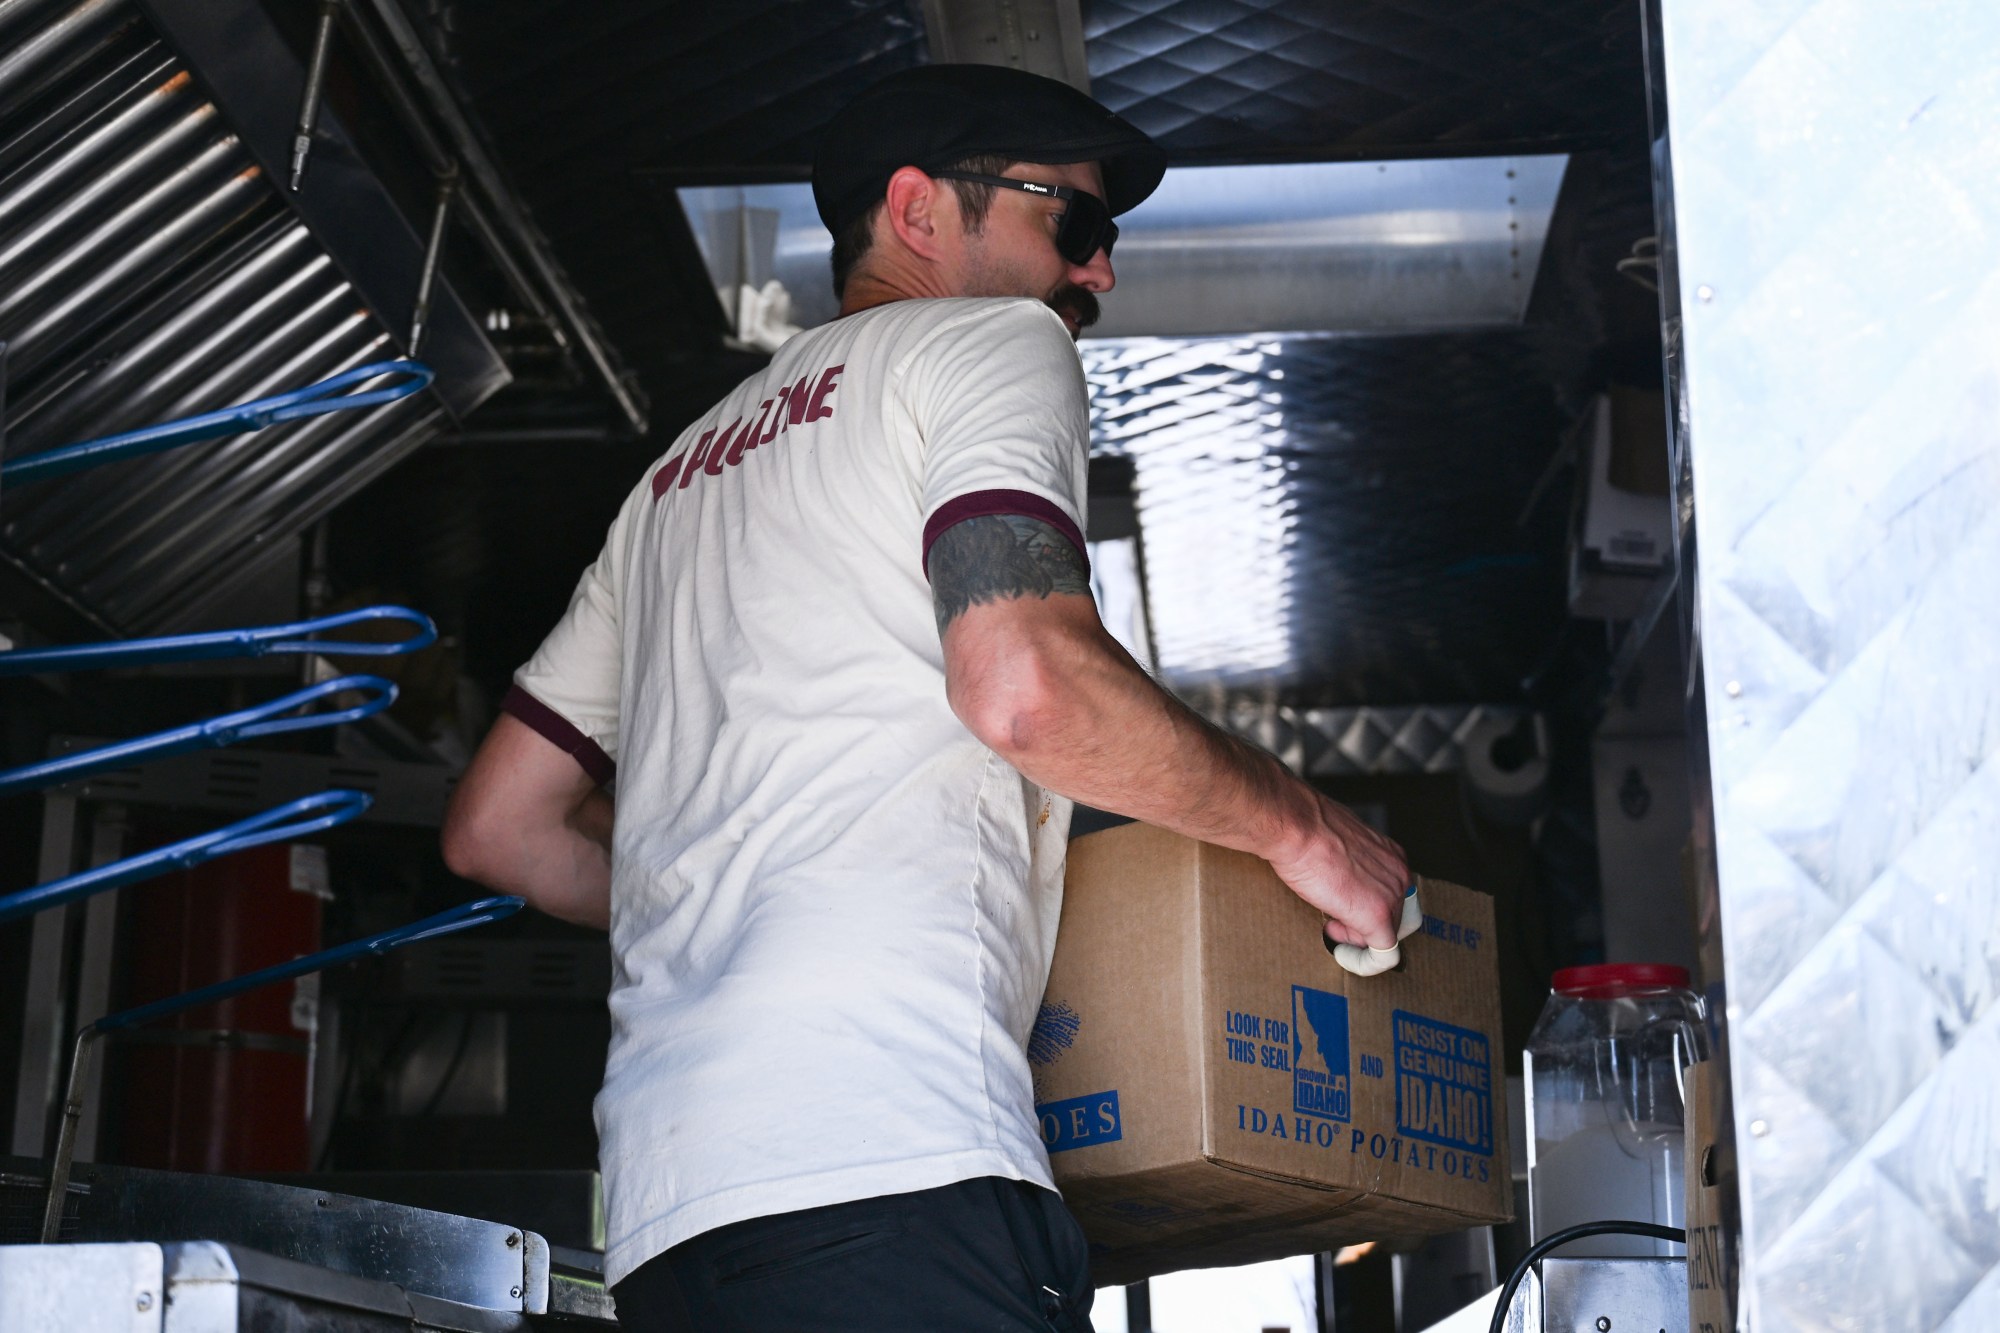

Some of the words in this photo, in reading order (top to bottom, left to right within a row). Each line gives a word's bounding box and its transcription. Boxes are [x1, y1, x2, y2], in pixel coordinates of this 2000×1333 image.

[1420, 914, 1448, 941] TORE
[1449, 922, 1462, 945] AT
[1226, 1010, 1261, 1039] LOOK
[1264, 1018, 1289, 1045] FOR
[1398, 1019, 1457, 1056] INSIST
[1460, 1035, 1487, 1065] ON
[1226, 1037, 1256, 1065] THIS
[1260, 1044, 1292, 1072] SEAL
[1360, 1053, 1384, 1079] AND
[1399, 1046, 1488, 1091] GENUINE
[1298, 1082, 1347, 1116] IDAHO
[1400, 1073, 1489, 1148] IDAHO!
[1350, 1127, 1489, 1184] POTATOES
